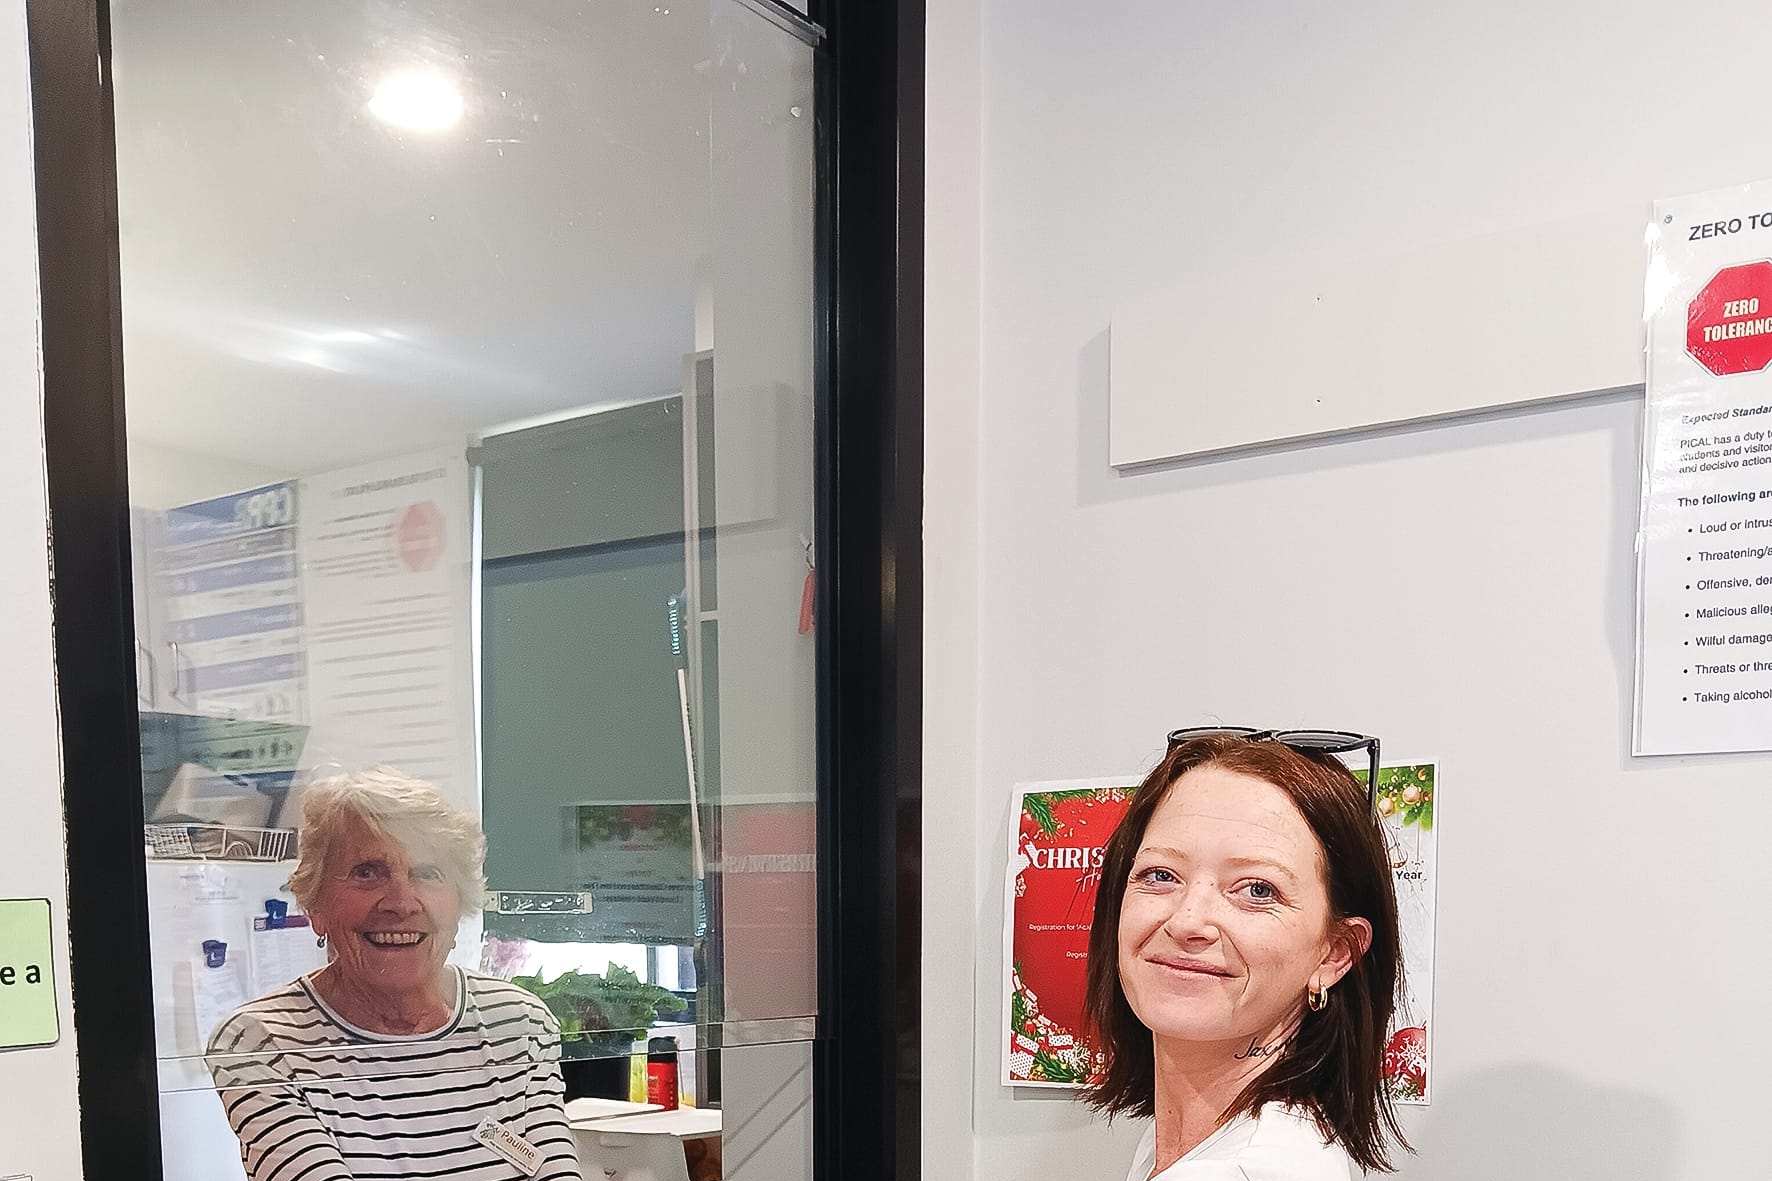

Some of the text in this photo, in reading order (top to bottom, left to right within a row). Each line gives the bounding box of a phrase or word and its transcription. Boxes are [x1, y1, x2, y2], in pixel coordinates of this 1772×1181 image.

[1689, 212, 1772, 241] ZERO TO
[1703, 297, 1772, 343] ZERO TOLERANC
[1680, 437, 1711, 448] PICAL
[1713, 436, 1732, 444] has
[1743, 431, 1764, 441] duty
[1723, 446, 1742, 456] and
[1700, 460, 1739, 471] decisive
[1677, 497, 1699, 507] The
[1702, 491, 1756, 502] following
[1700, 521, 1727, 533] Loud
[1730, 522, 1742, 530] or
[1697, 577, 1752, 590] Offensive,
[1696, 606, 1747, 618] Malicious
[1695, 634, 1772, 646] Wilful damage
[1695, 664, 1736, 674] Threats
[1739, 664, 1750, 672] or
[1694, 689, 1772, 703] Taking alcohol
[1396, 871, 1423, 880] Year
[25, 964, 41, 984] a
[500, 1130, 535, 1160] Pauline
